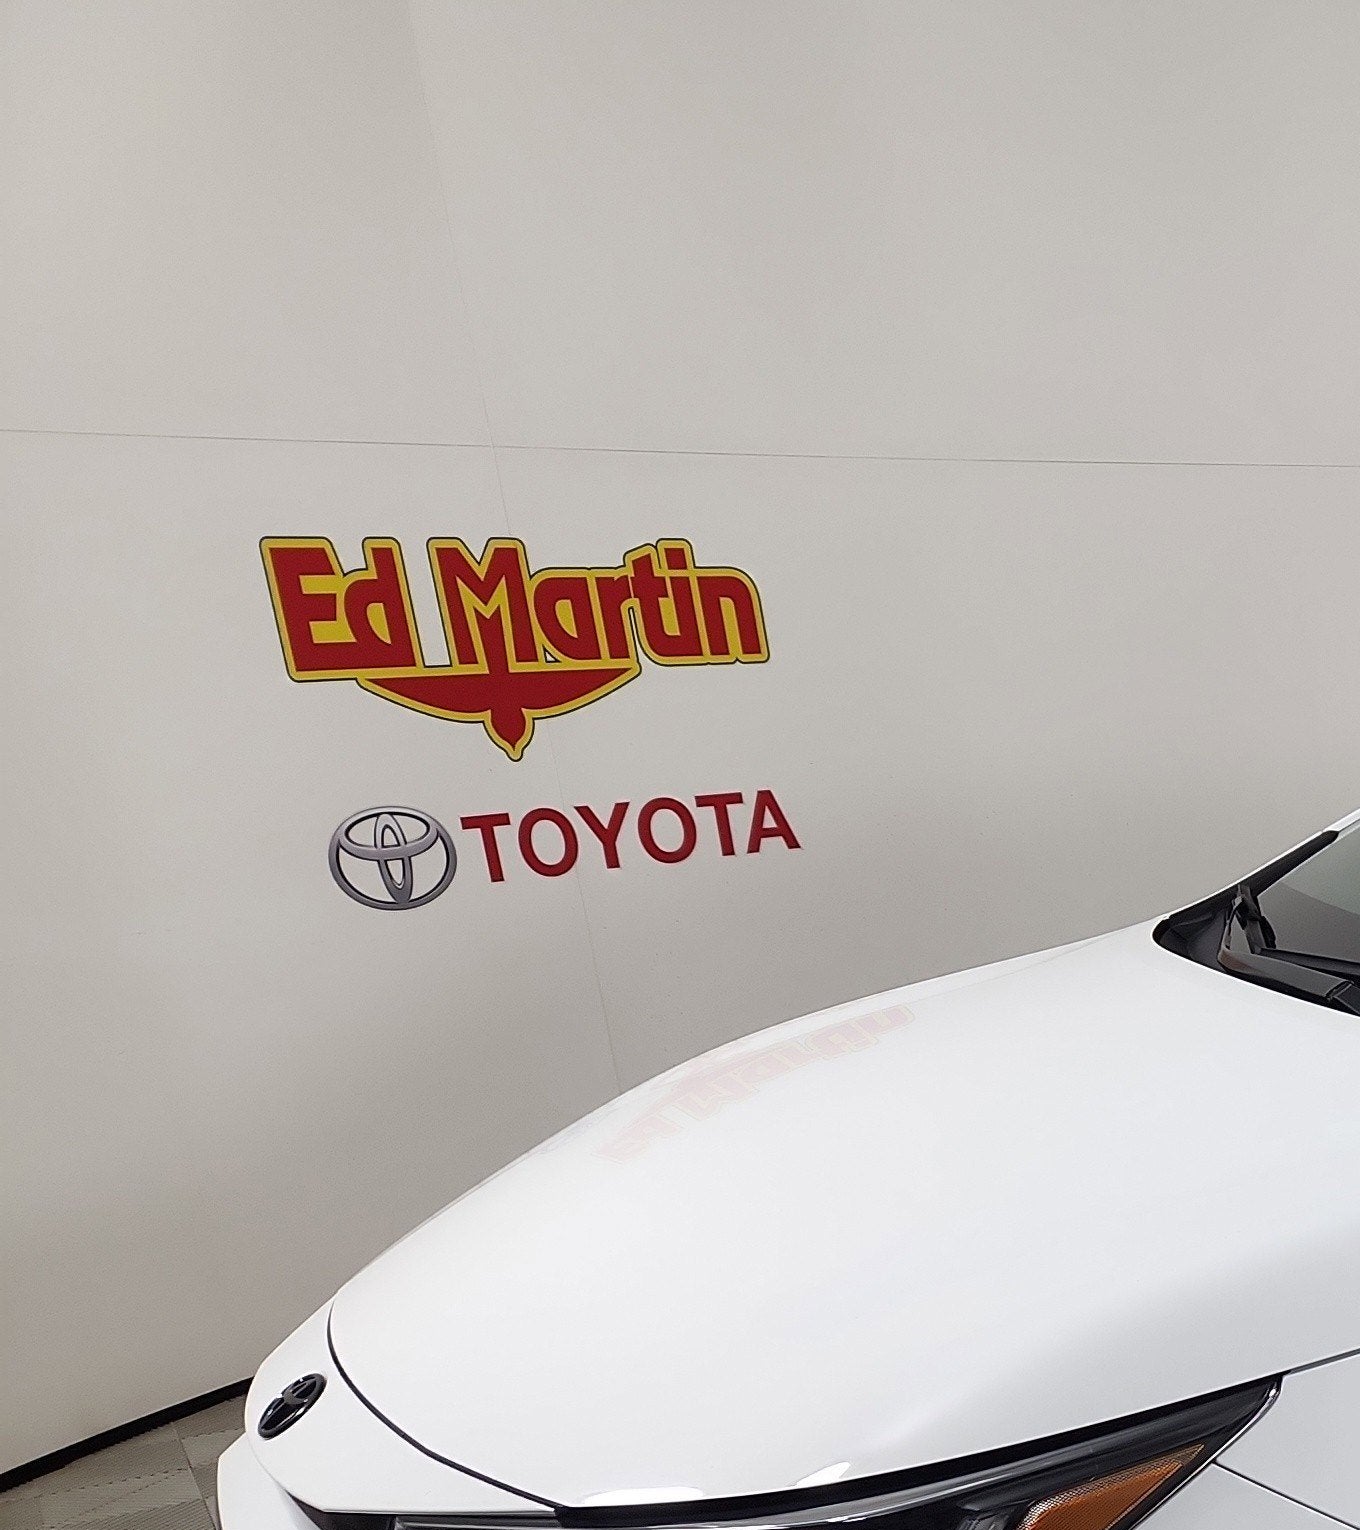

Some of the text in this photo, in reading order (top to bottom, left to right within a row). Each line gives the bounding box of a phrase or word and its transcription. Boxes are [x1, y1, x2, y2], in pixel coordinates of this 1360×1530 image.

[262, 538, 768, 679] Ed Martin
[461, 790, 801, 882] TOYOTA
